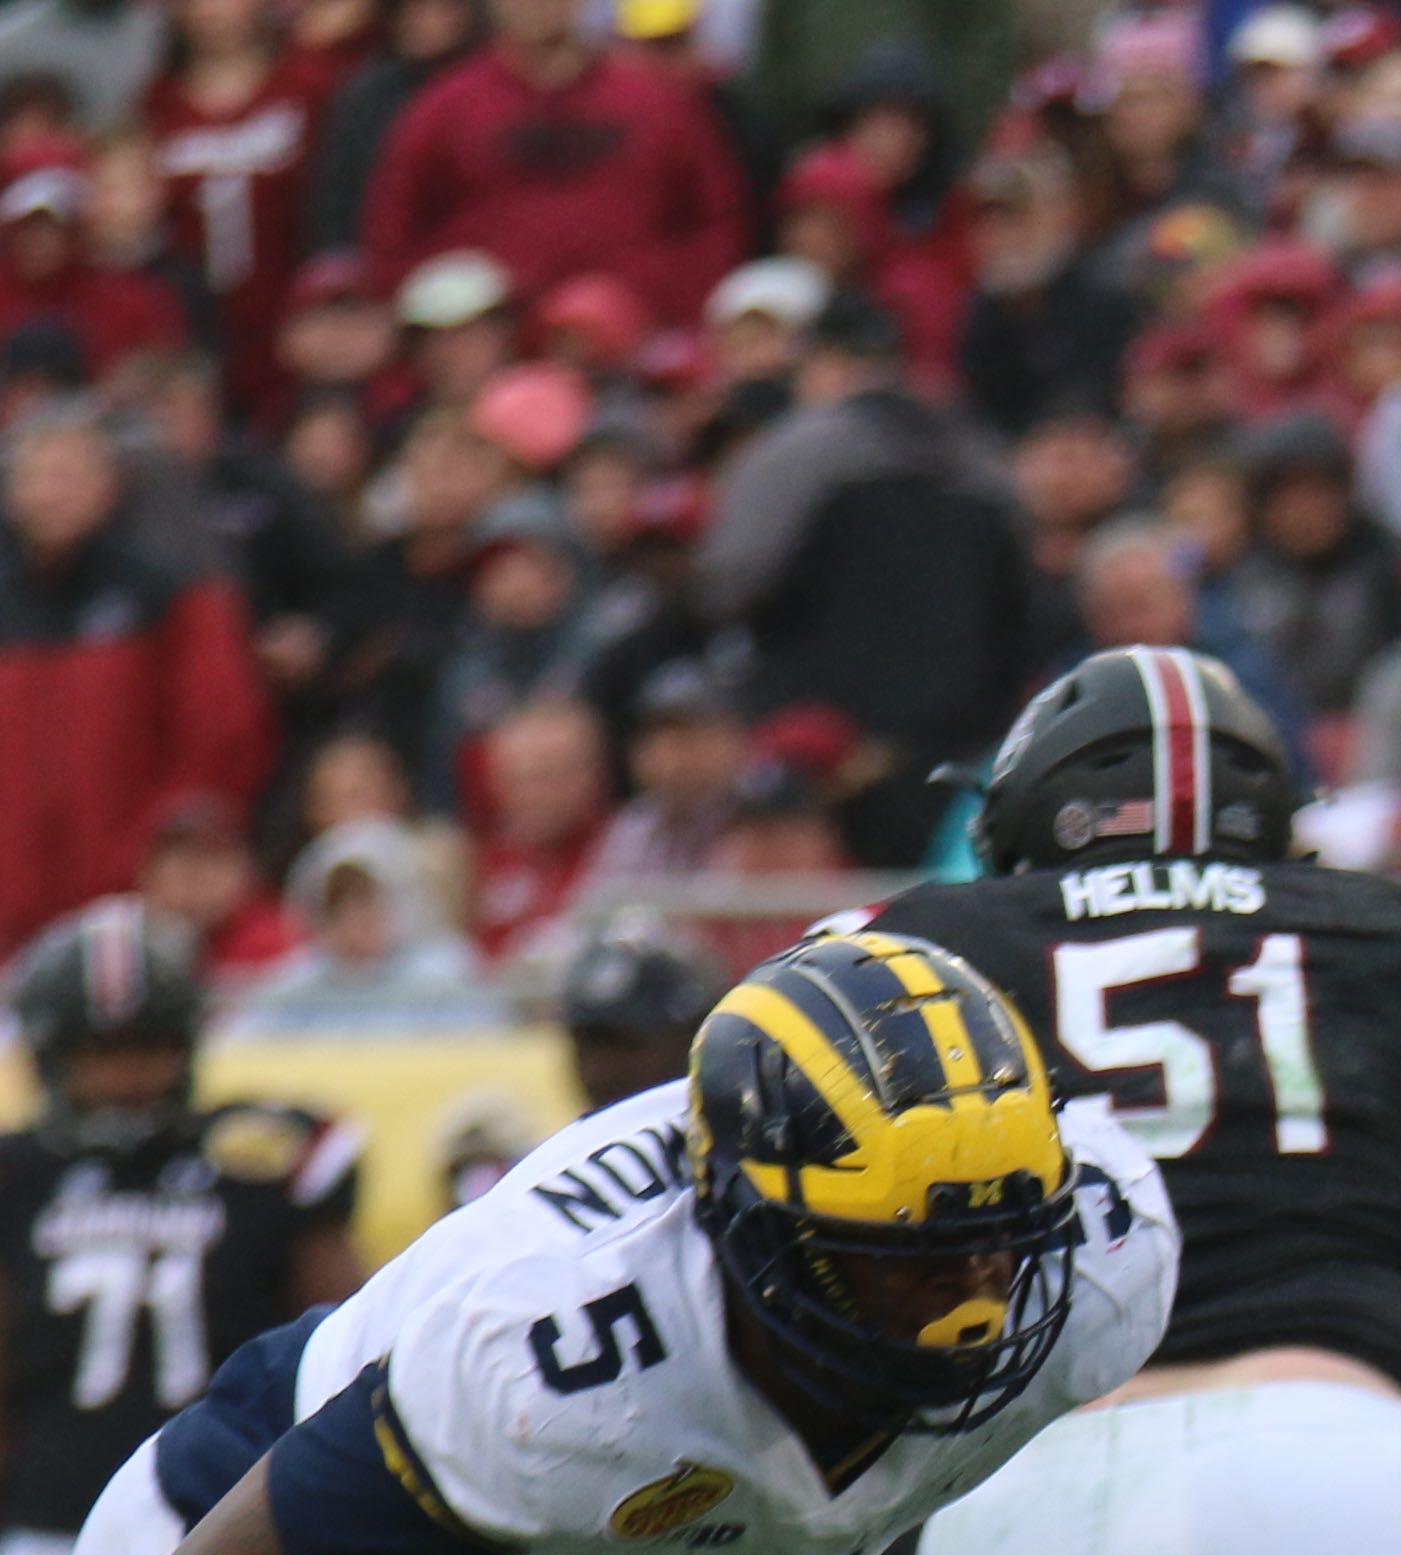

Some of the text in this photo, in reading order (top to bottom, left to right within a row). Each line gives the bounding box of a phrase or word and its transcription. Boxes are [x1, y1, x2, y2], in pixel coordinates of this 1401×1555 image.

[1058, 860, 1267, 922] HELMS
[1048, 927, 1331, 1159] 51
[46, 1250, 211, 1410] 71
[527, 1283, 669, 1397] 5
